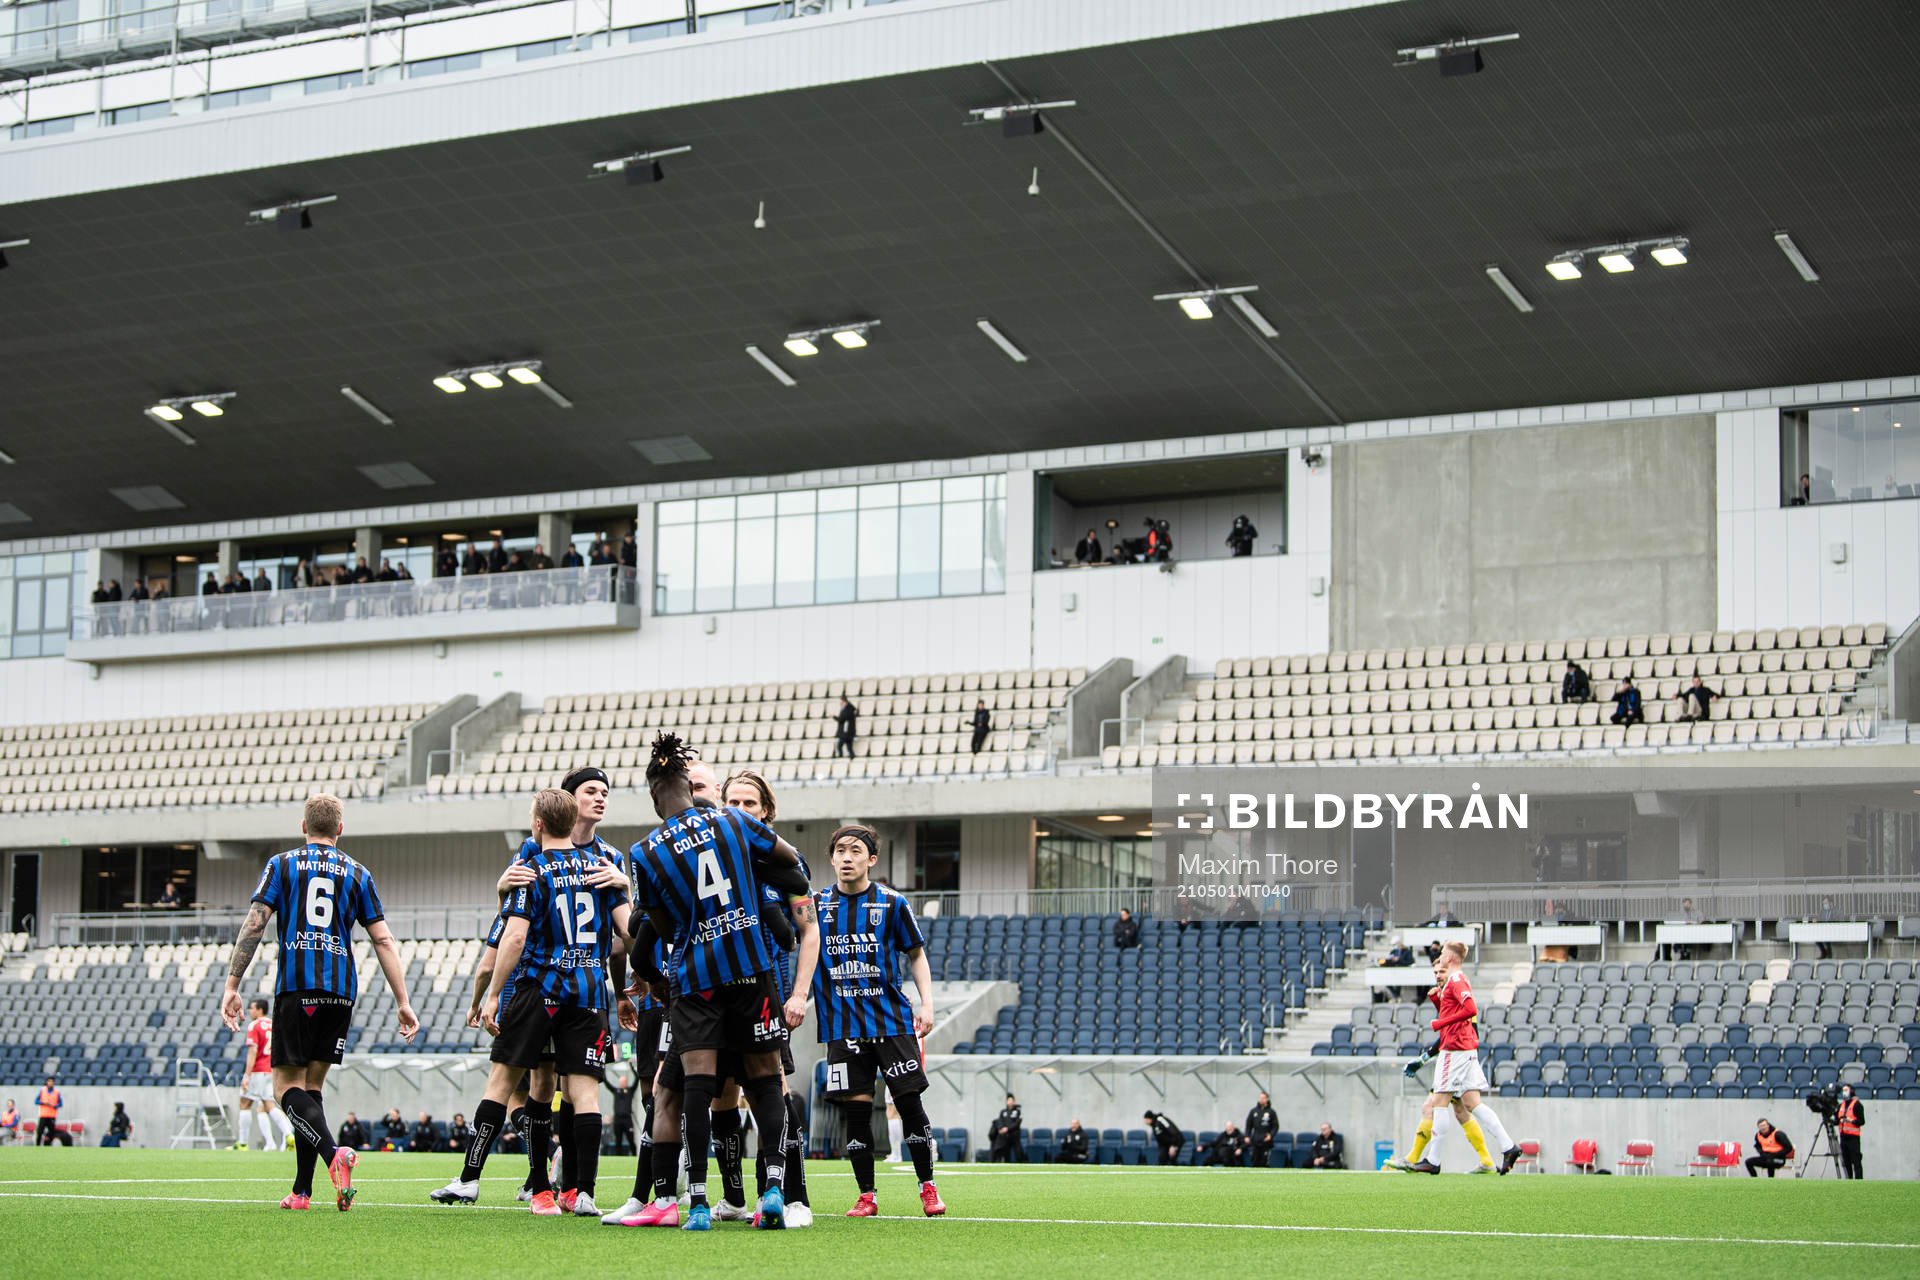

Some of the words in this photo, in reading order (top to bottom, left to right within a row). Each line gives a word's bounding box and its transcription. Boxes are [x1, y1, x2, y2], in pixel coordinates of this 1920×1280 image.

[701, 809, 727, 820] TAK
[673, 827, 717, 854] COLLEY
[296, 860, 348, 877] MATHISEN
[697, 848, 732, 906] 4
[306, 877, 335, 928] 6
[555, 891, 597, 944] 12
[698, 907, 746, 932] NORDIC
[296, 931, 340, 945] NORDC
[691, 914, 759, 945] WELLNESS
[825, 934, 849, 945] BYGG
[285, 940, 348, 957] WELLNESS
[826, 943, 880, 955] CONSTRUCT
[549, 958, 601, 969] WELLESS
[843, 987, 884, 997] BILFORUM
[621, 1042, 632, 1059] 9
